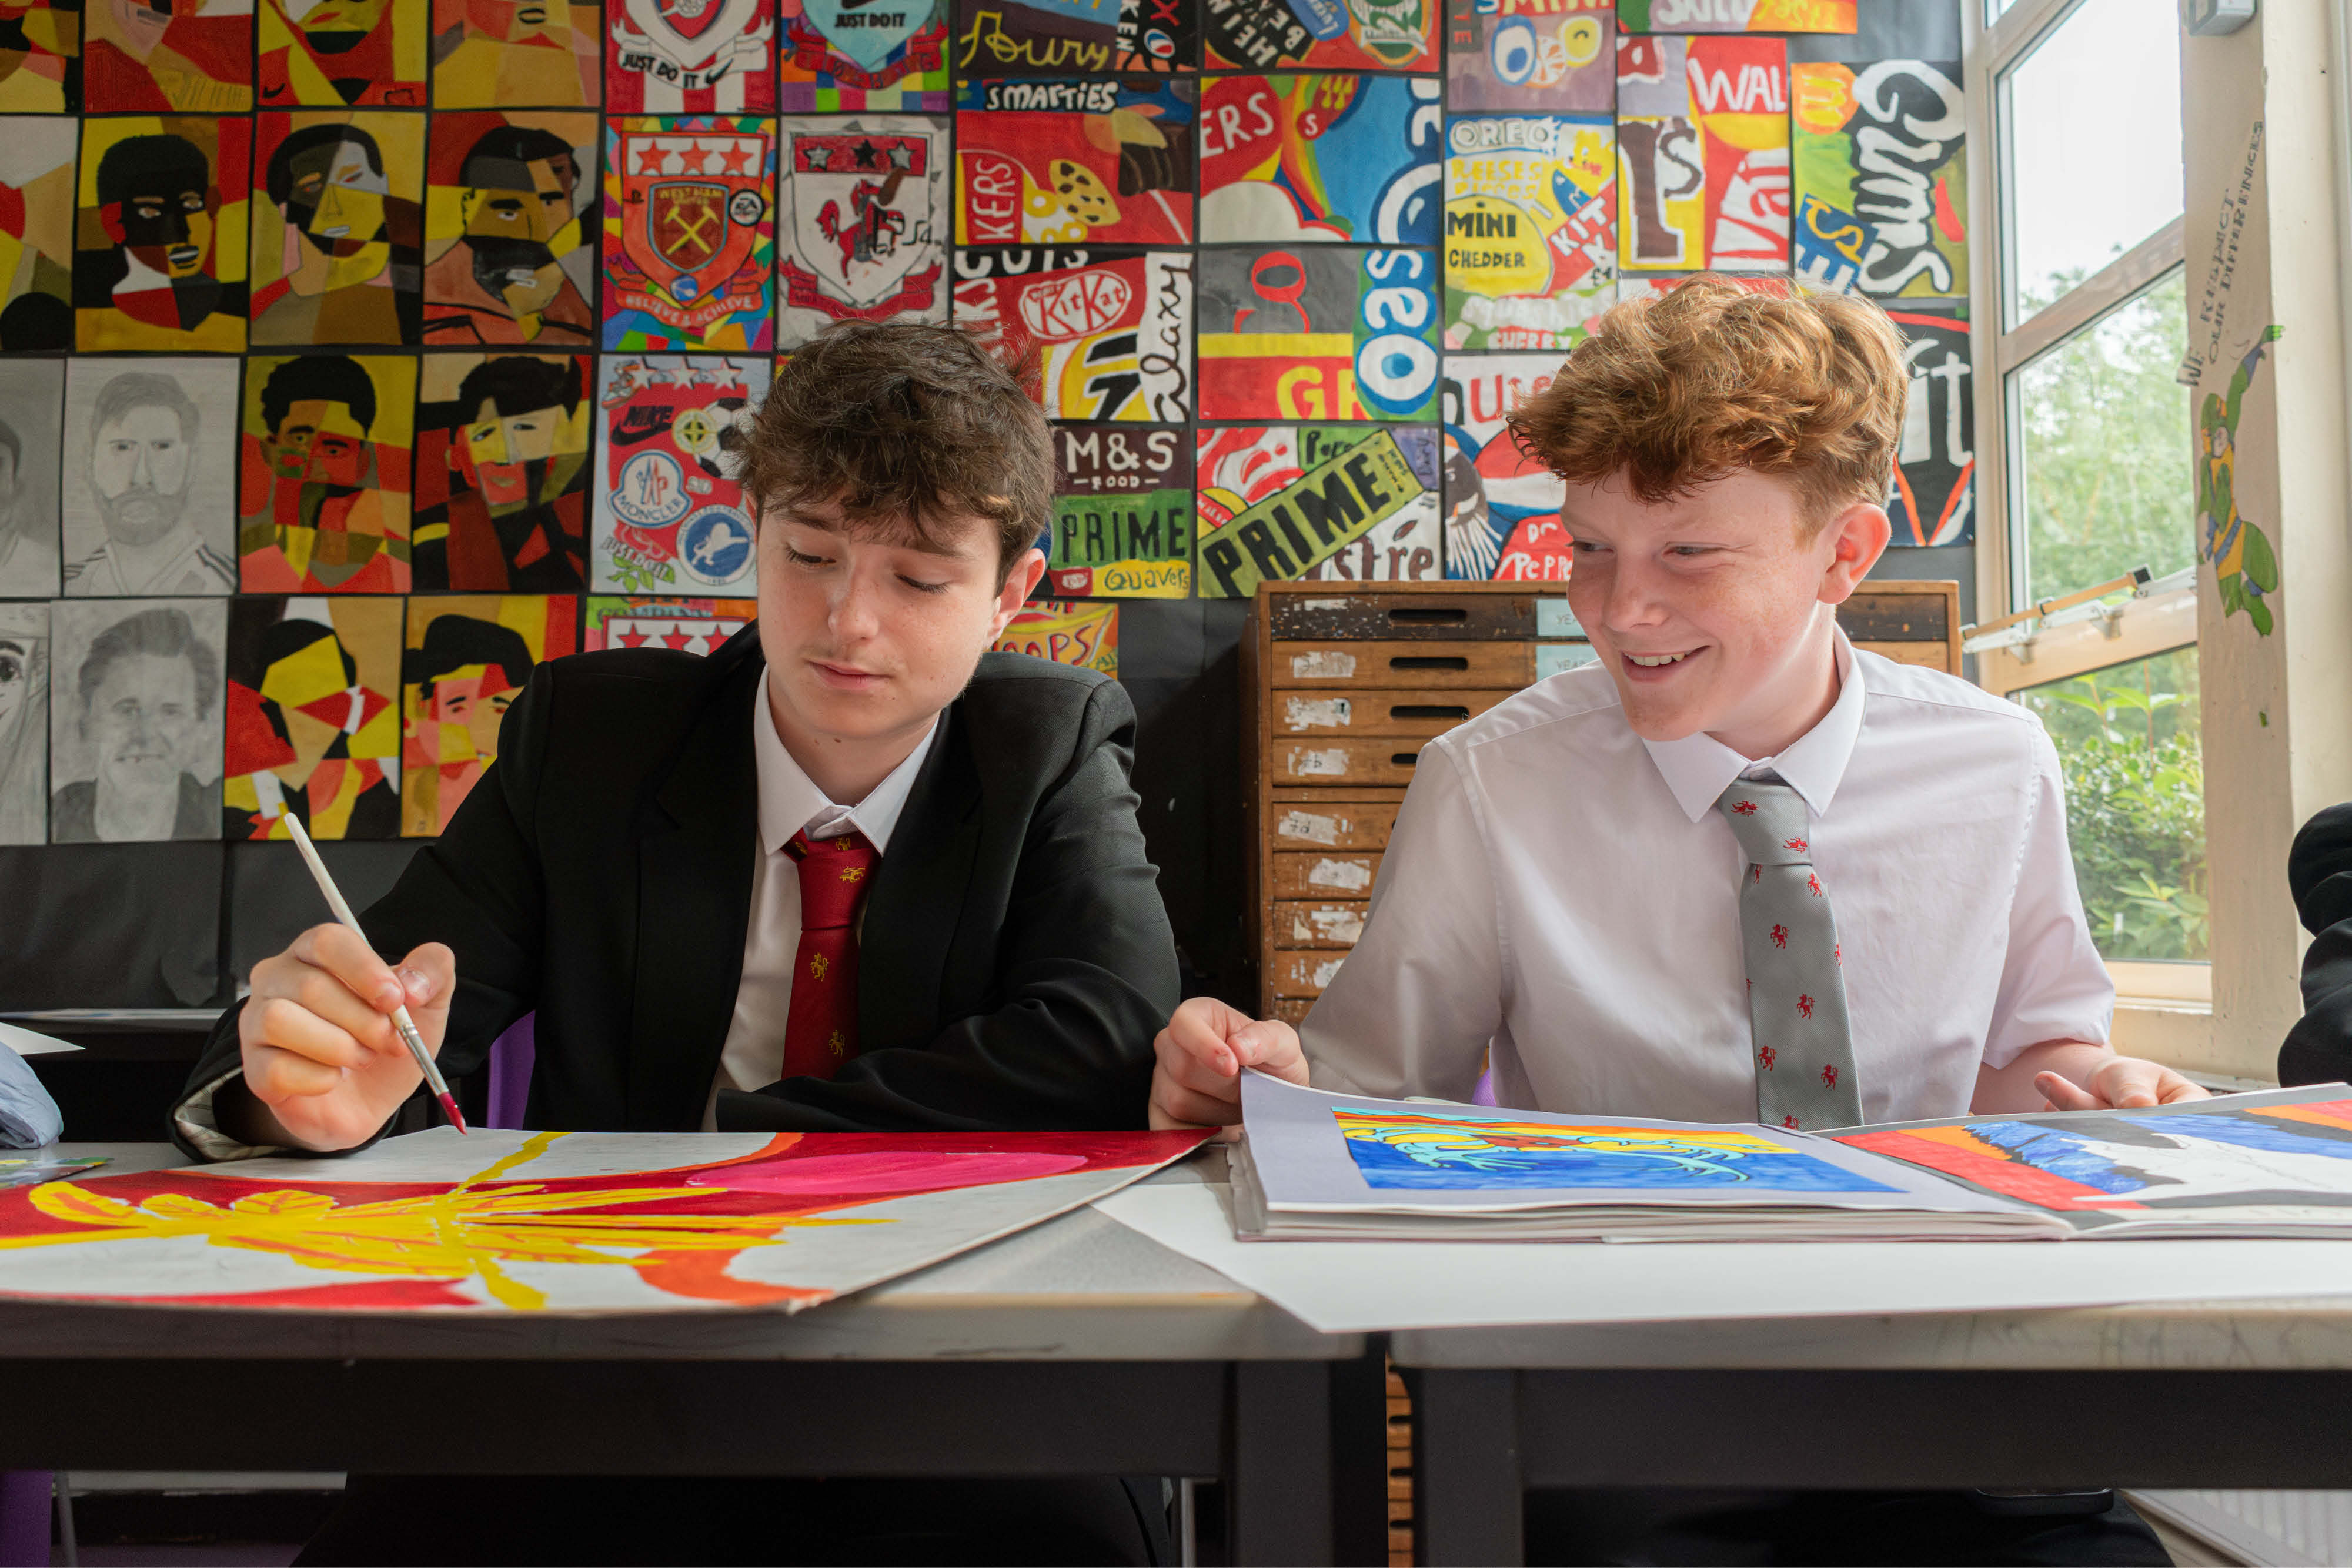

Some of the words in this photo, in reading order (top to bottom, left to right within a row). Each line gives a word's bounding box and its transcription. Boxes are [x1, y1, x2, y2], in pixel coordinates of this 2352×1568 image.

[622, 53, 656, 71] JUST
[656, 62, 679, 81] DO
[683, 74, 699, 89] IT
[1686, 58, 1788, 112] WAL
[1454, 119, 1550, 151] OREO
[1549, 195, 1608, 257] KIT
[1449, 249, 1526, 268] CHEDDER
[1065, 430, 1178, 473] M&S
[1091, 475, 1141, 490] FOOD
[1060, 508, 1187, 563] PRIME
[1202, 452, 1392, 599] PRIME
